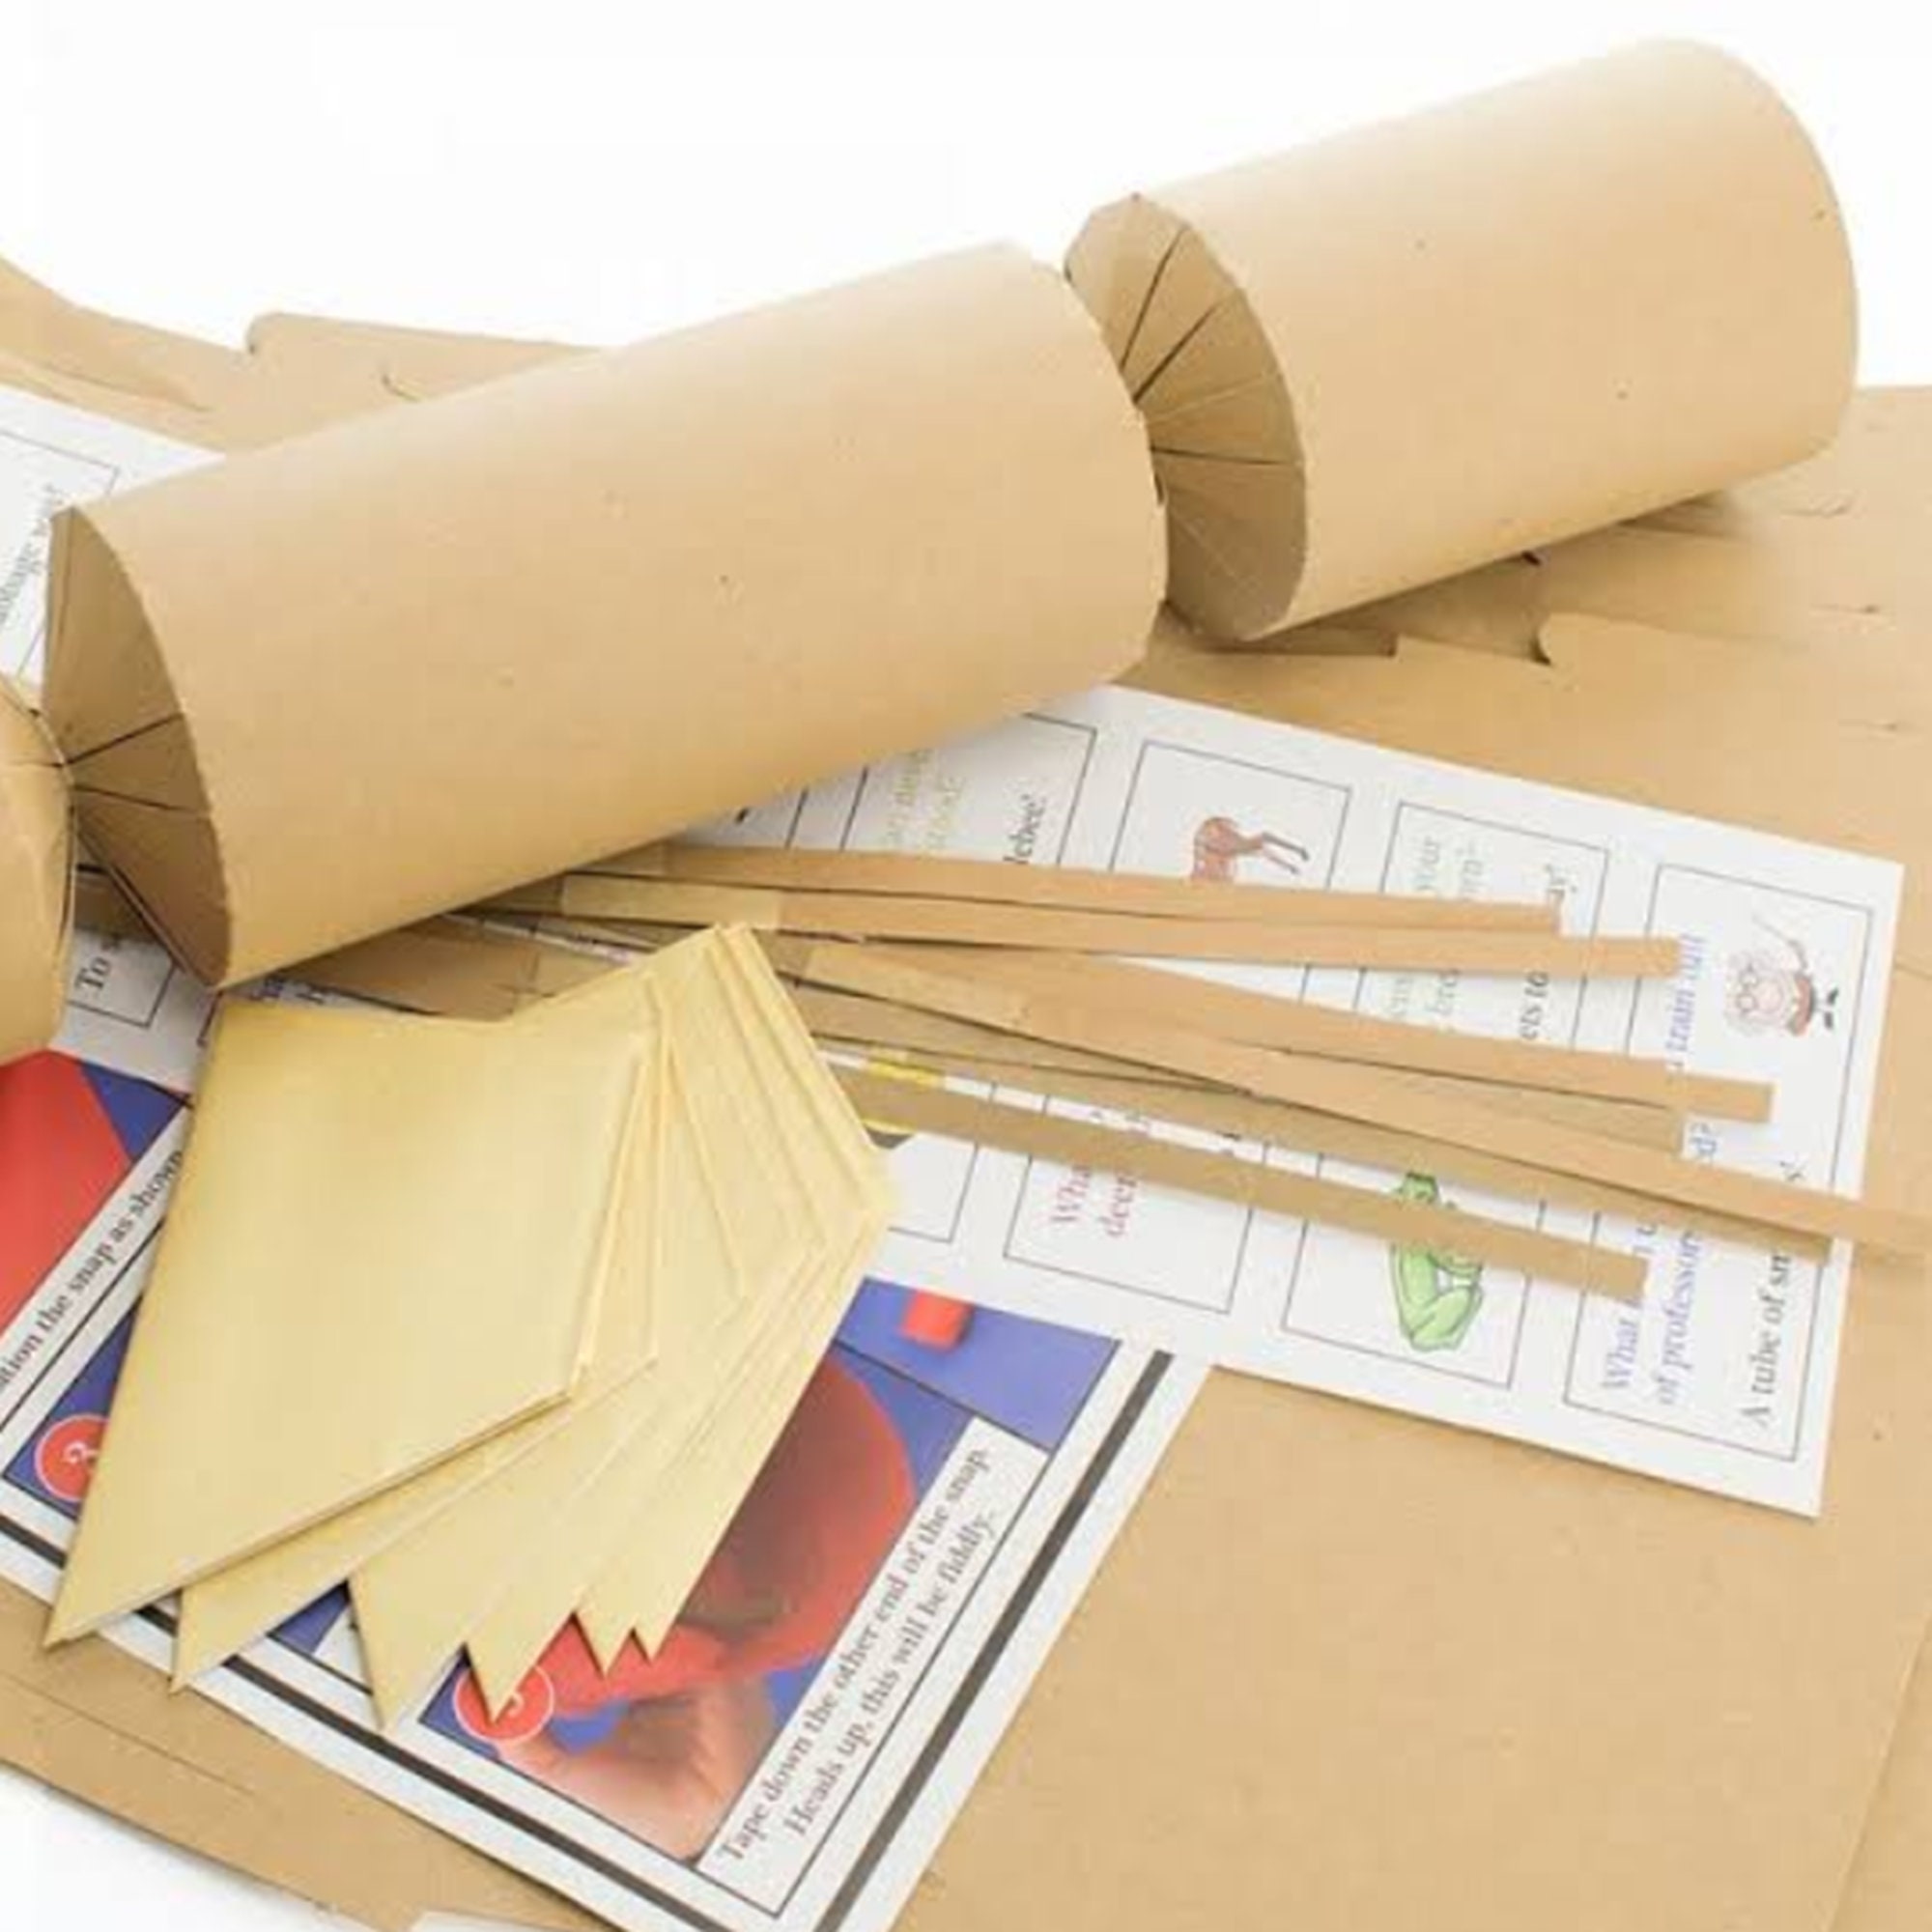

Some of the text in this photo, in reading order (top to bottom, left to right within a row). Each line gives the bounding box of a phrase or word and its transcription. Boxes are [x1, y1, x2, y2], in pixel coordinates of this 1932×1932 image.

[74, 957, 112, 989] To
[1666, 988, 1697, 1053] train
[1048, 1163, 1094, 1225] Wha
[36, 1295, 70, 1332] the
[69, 1240, 118, 1295] snap
[110, 1217, 134, 1243] as
[128, 1150, 184, 1216] shown
[1755, 1285, 1786, 1326] of
[1600, 1315, 1639, 1390] What
[1748, 1328, 1781, 1396] tube
[1650, 1368, 1681, 1406] of
[1742, 1405, 1773, 1431] A
[719, 1804, 773, 1861] Tape
[763, 1736, 813, 1804] down
[803, 1691, 838, 1734] the
[833, 1626, 880, 1690] other
[874, 1573, 910, 1623] end
[900, 1541, 928, 1575] of
[917, 1504, 950, 1546] the
[783, 1759, 843, 1837] Heads
[859, 1668, 901, 1717] this
[890, 1615, 930, 1667] will
[916, 1584, 949, 1618] be
